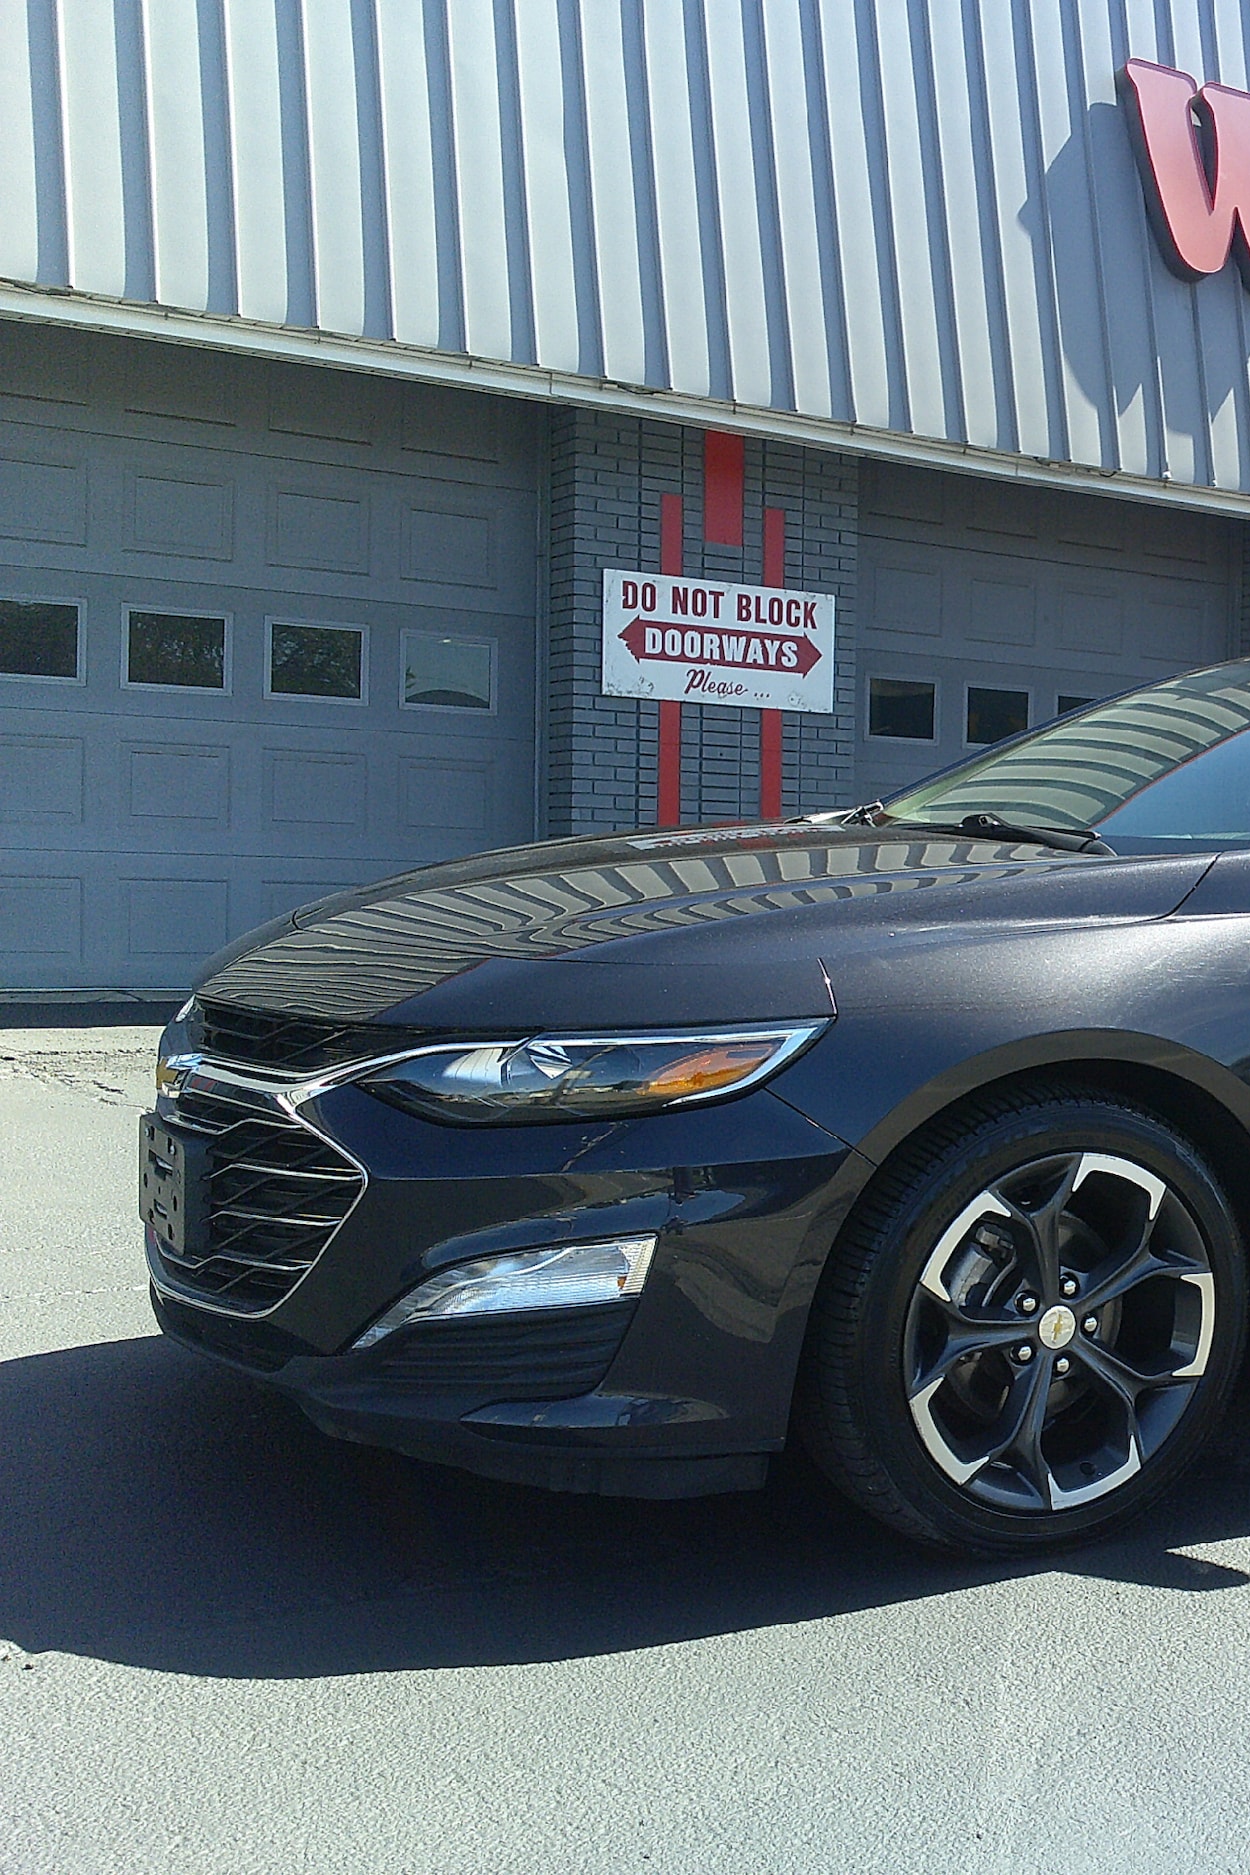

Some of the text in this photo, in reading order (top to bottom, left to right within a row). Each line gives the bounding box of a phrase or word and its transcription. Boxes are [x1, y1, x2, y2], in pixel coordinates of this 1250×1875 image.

[622, 580, 817, 630] DO NOT BLOCK
[645, 627, 798, 668] DOORWAYS
[684, 668, 748, 695] Please
